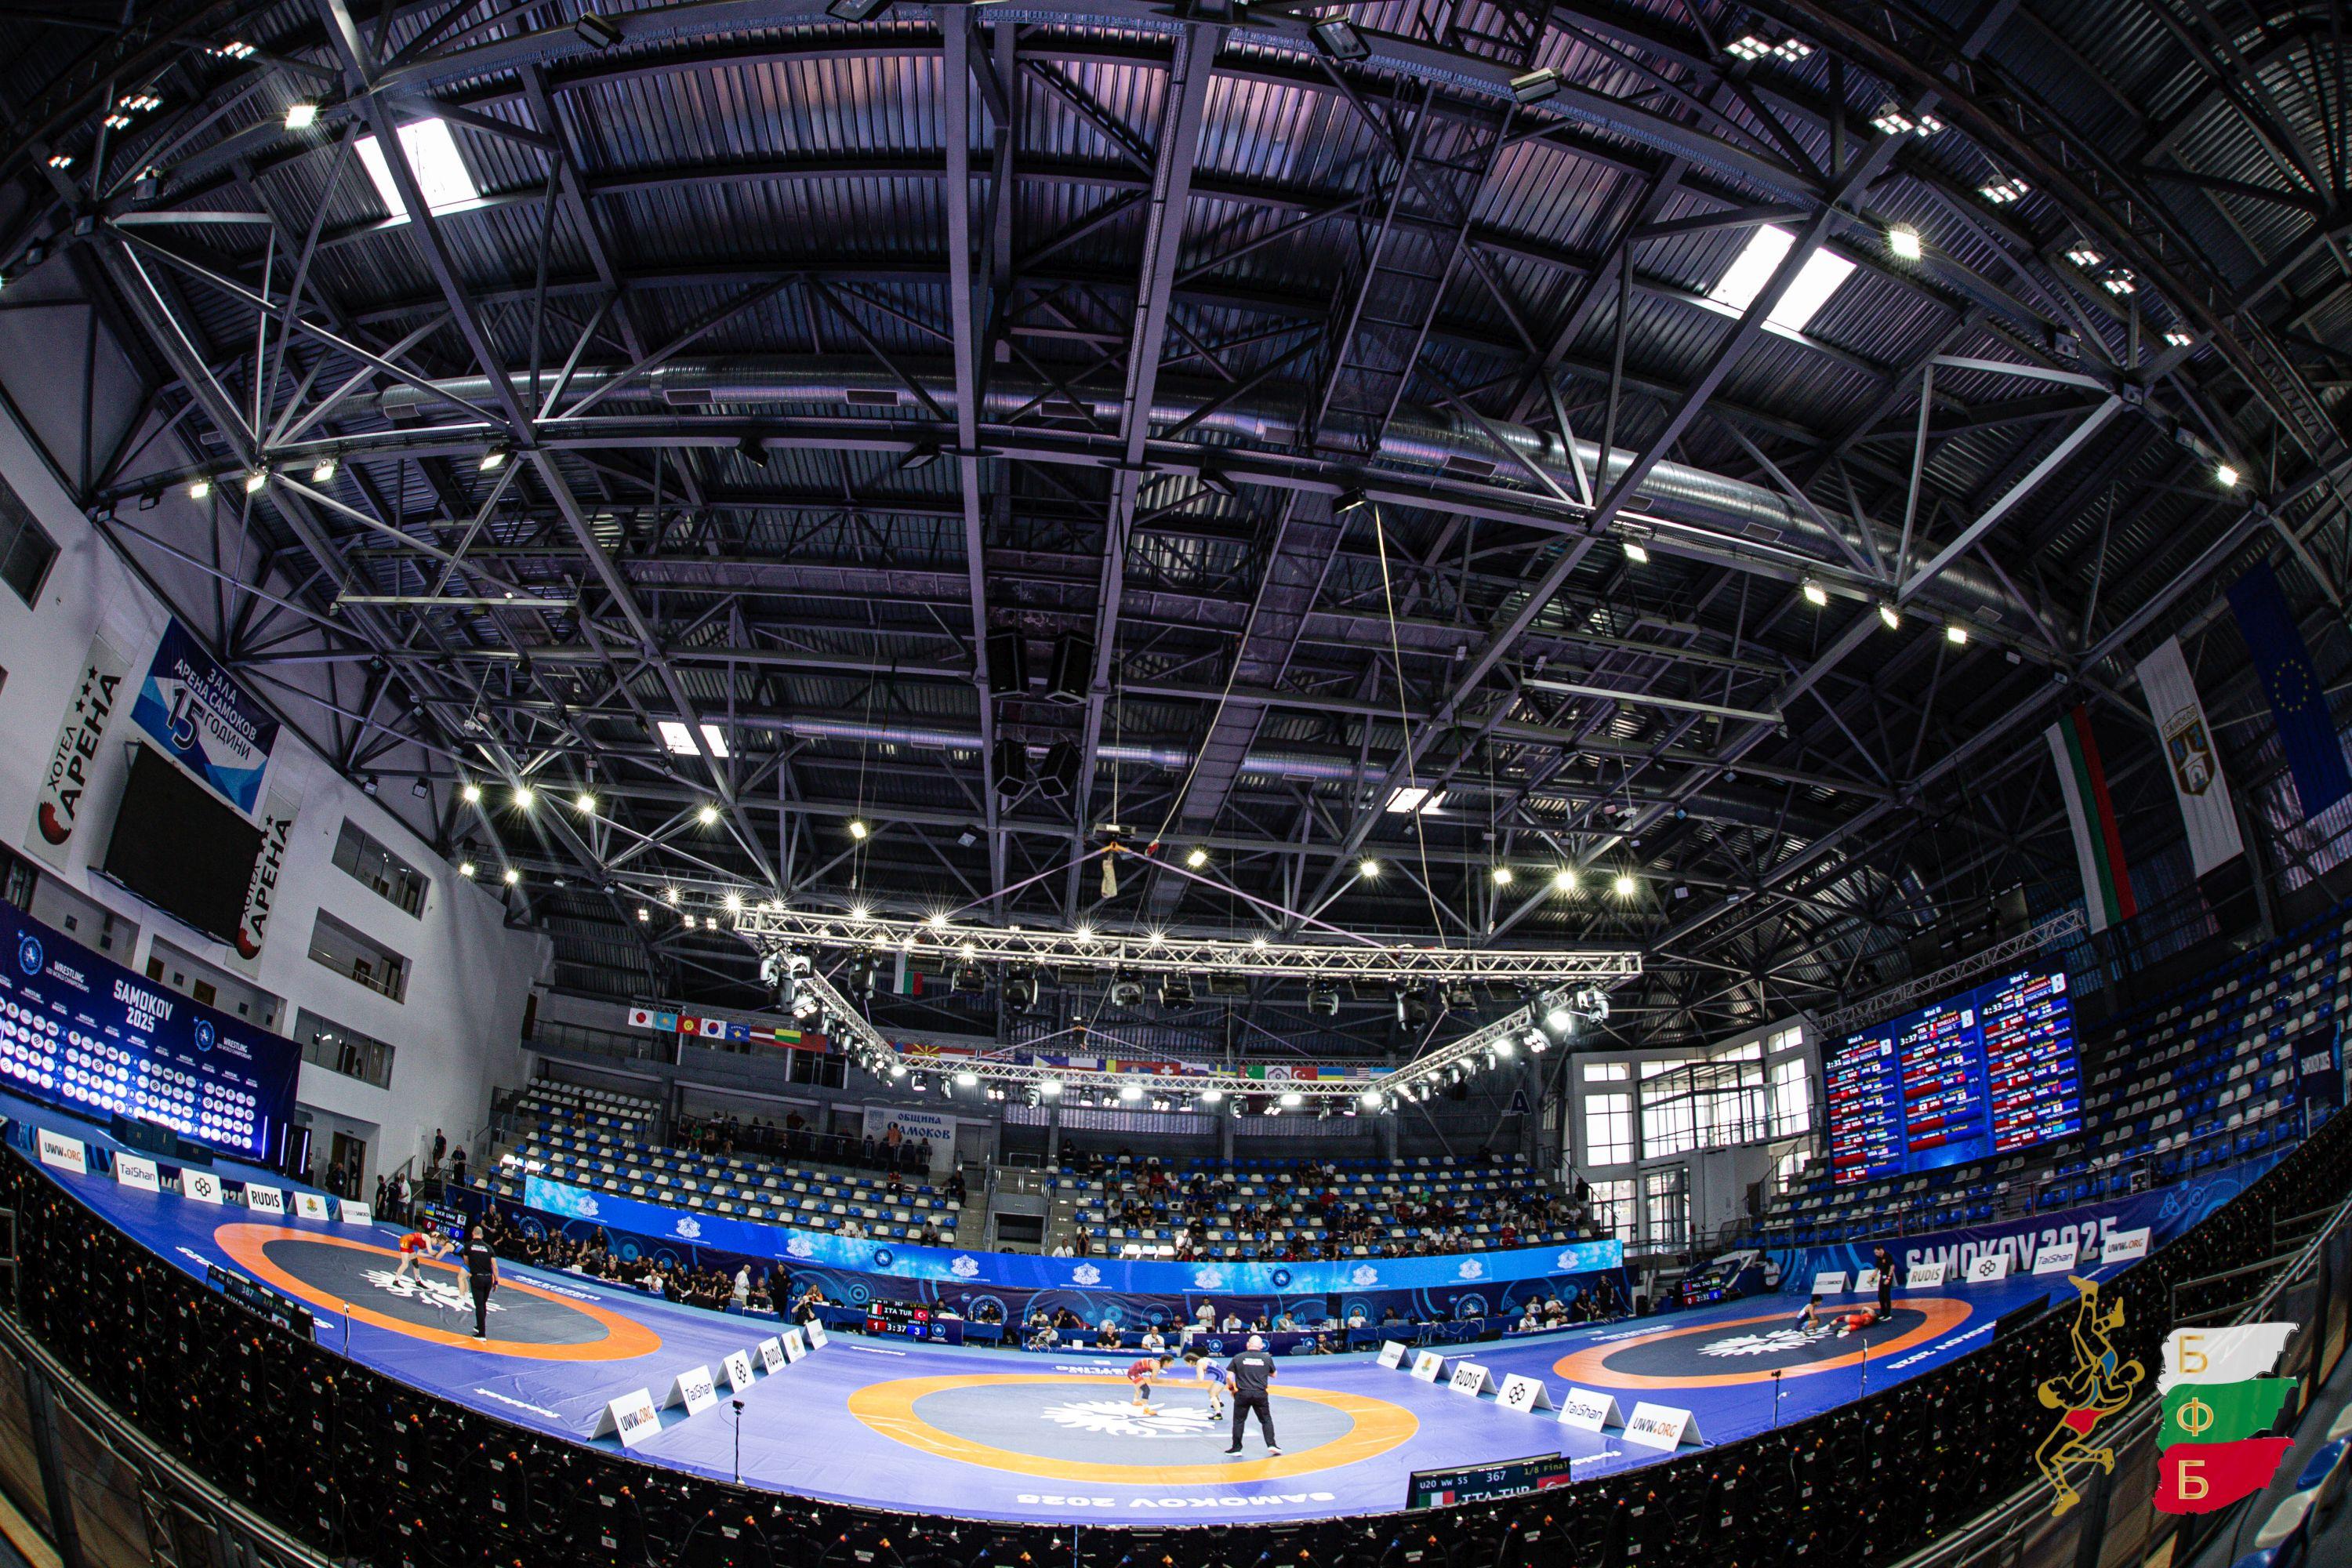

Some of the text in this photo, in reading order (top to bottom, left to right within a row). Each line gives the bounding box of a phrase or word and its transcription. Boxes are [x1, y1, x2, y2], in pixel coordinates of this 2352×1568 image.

[207, 668, 237, 704] ЗАЛА
[174, 659, 256, 741] АРЕНА САМОКОВ
[166, 686, 251, 760] 15 ГОДИНИ
[60, 674, 122, 822] АРЕНА
[47, 727, 78, 793] ХОТЕЛ
[250, 820, 292, 939] АРЕНА
[54, 960, 85, 983] WRESTLING
[113, 979, 173, 1021] SAMOKOV
[1983, 1003, 2002, 1014] 4:33
[125, 1006, 155, 1033] 2025
[224, 1036, 248, 1053] WRESTLING
[1900, 1034, 1917, 1045] 3:37
[1827, 1059, 1842, 1069] 2:31
[45, 1142, 82, 1162] UWW.ORG
[120, 1163, 155, 1181] TaiShan
[251, 1190, 280, 1207] RUDIS
[436, 1224, 450, 1234] 4:32
[2107, 1237, 2143, 1253] UWW.ORG
[2038, 1253, 2073, 1265] TaiShan
[1911, 1268, 1940, 1283] RUDIS
[241, 1284, 255, 1298] 387
[887, 1323, 906, 1332] 3:37
[764, 1346, 782, 1367] RUDIS
[1454, 1369, 1480, 1390] RUDIS
[684, 1381, 713, 1403] TaiShan
[620, 1405, 654, 1432] UWW.ORG
[1565, 1400, 1602, 1421] TaiShan
[1632, 1417, 1679, 1438] UWW.ORG
[1419, 1479, 1437, 1490] U20
[1457, 1475, 1468, 1485] 55
[1486, 1471, 1507, 1483] 367
[1523, 1465, 1539, 1476] 1/8
[1544, 1461, 1567, 1473] Final
[1016, 1491, 1336, 1508] SAMOKOV 2025
